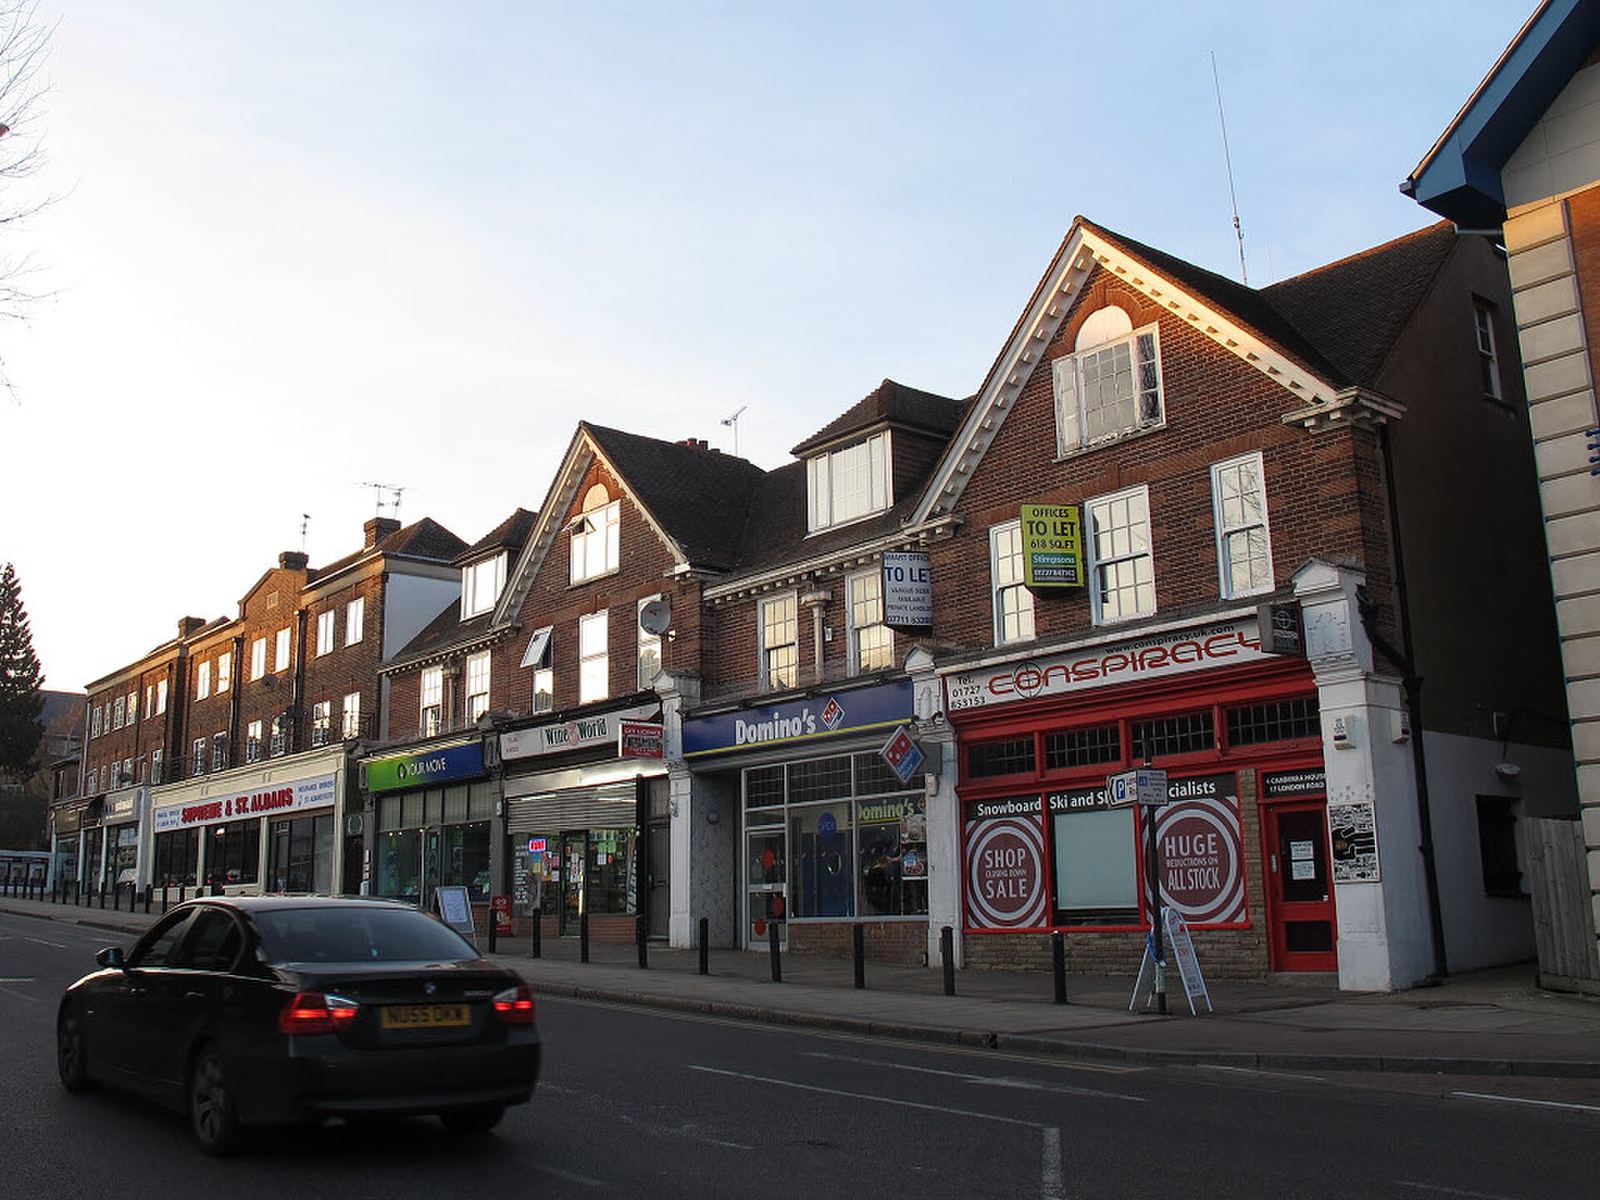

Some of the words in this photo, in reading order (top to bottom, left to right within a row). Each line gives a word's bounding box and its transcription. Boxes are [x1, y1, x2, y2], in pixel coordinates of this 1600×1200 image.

[1032, 508, 1069, 518] OFFICES
[1026, 521, 1047, 536] TO
[1053, 521, 1076, 536] LET
[1031, 539, 1047, 549] 618
[1033, 554, 1075, 565] Stimpsons
[884, 566, 904, 582] TO
[952, 685, 981, 698] 01727
[735, 707, 817, 745] Domino's
[224, 802, 233, 817] &
[250, 787, 294, 812] ALBANS
[977, 797, 1042, 817] Snowboard
[1049, 794, 1067, 810] Ski
[1070, 791, 1094, 808] and
[1165, 833, 1218, 857] HUGE
[985, 848, 1026, 869] SHOP
[985, 879, 1027, 899] SALE
[1168, 869, 1187, 891] ALL
[1187, 867, 1220, 890] STOCK
